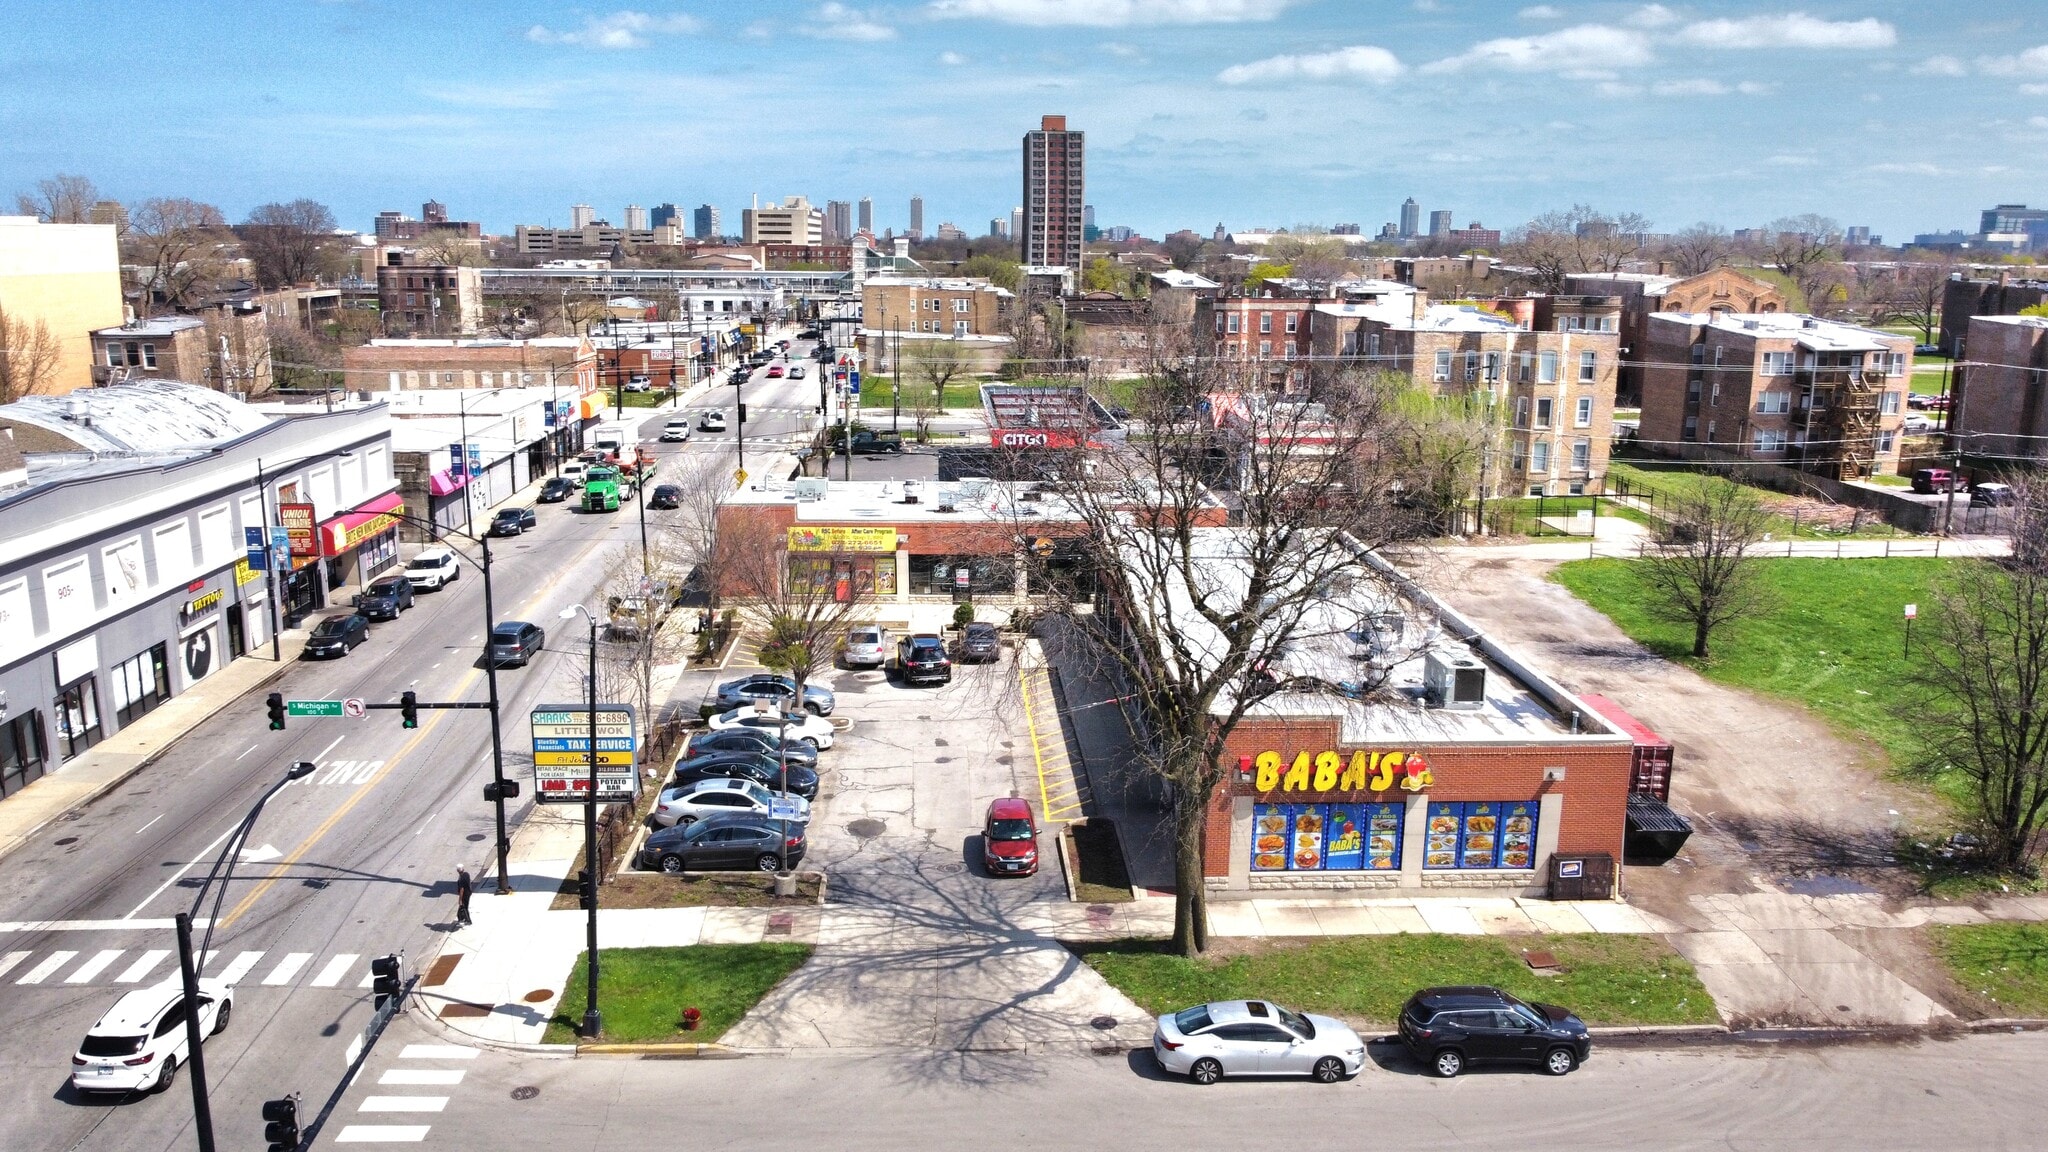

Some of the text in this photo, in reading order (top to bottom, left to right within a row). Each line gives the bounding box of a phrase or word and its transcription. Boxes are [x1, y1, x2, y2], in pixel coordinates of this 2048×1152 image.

[1003, 434, 1047, 446] CITGO
[283, 509, 310, 519] UNION
[194, 589, 224, 610] TATTOOS
[297, 702, 329, 711] Michigan
[533, 713, 572, 723] SHARKS
[566, 740, 632, 750] TAX ERVICE
[1255, 750, 1404, 792] BABA'S
[1328, 838, 1361, 852] BABA'S
